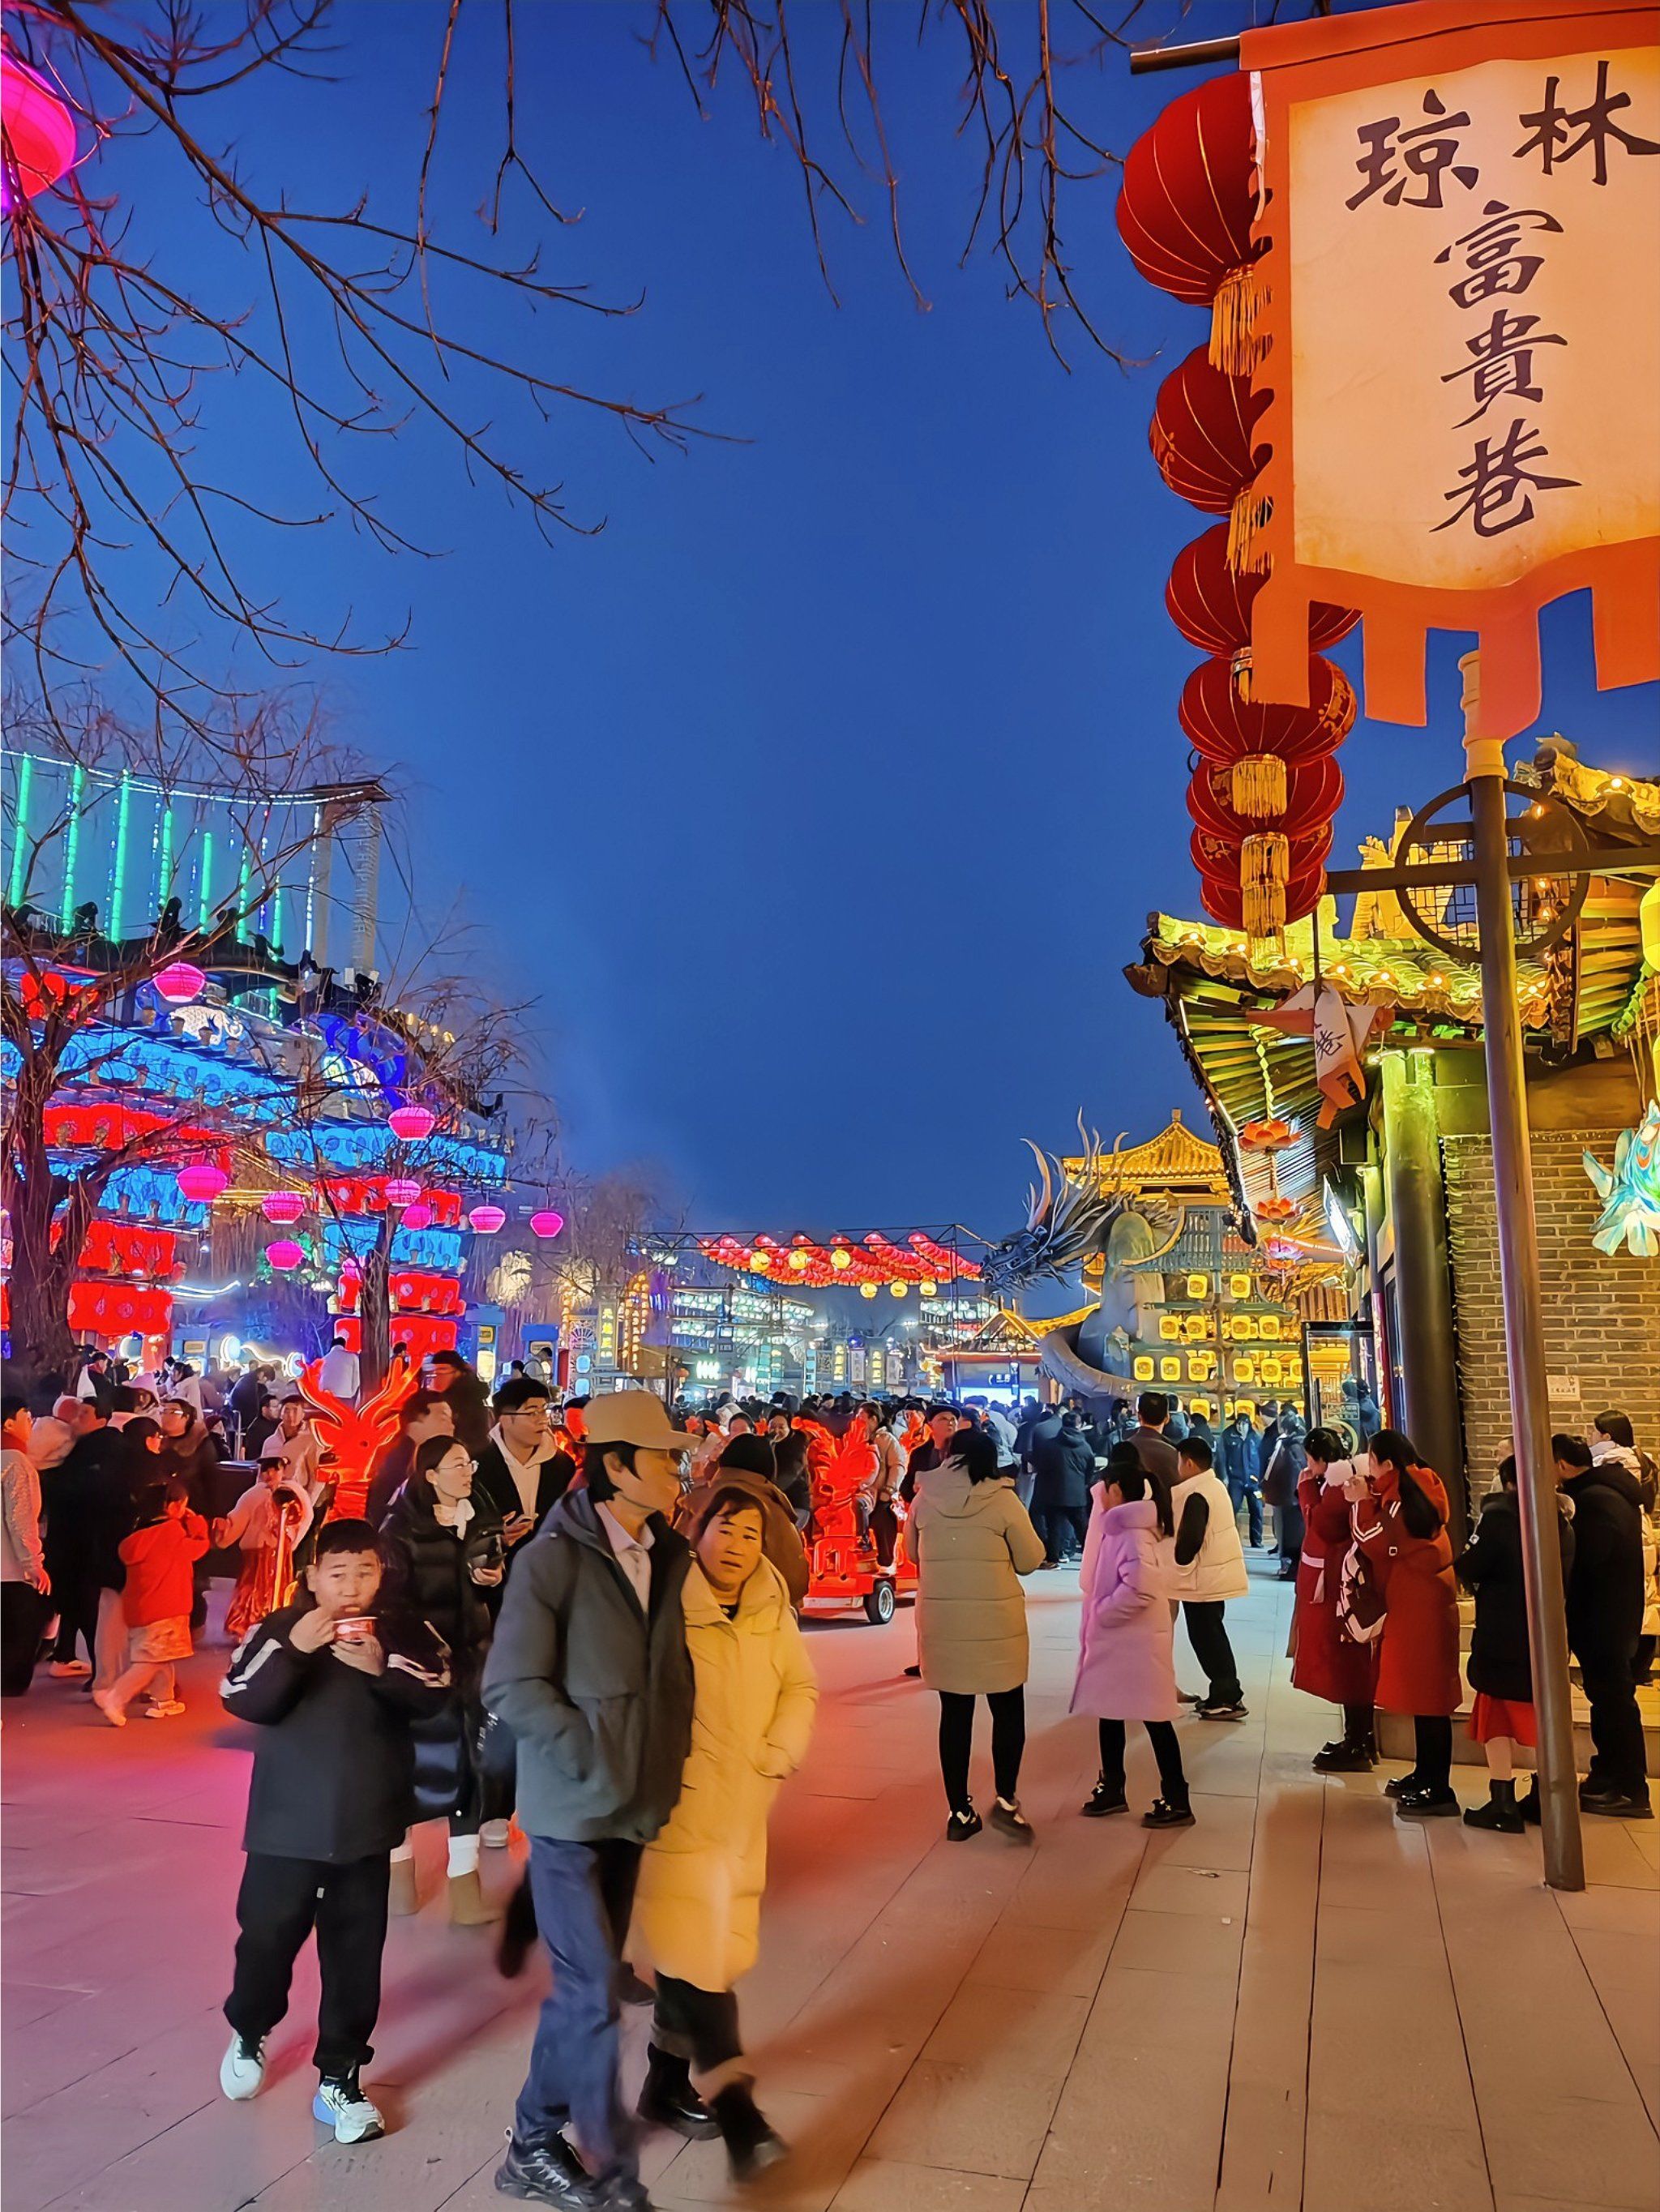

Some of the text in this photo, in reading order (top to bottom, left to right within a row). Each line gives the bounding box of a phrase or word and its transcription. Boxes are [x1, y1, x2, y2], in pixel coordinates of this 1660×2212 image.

[1346, 60, 1660, 211] 琼林
[1429, 199, 1582, 537] 富貴巷
